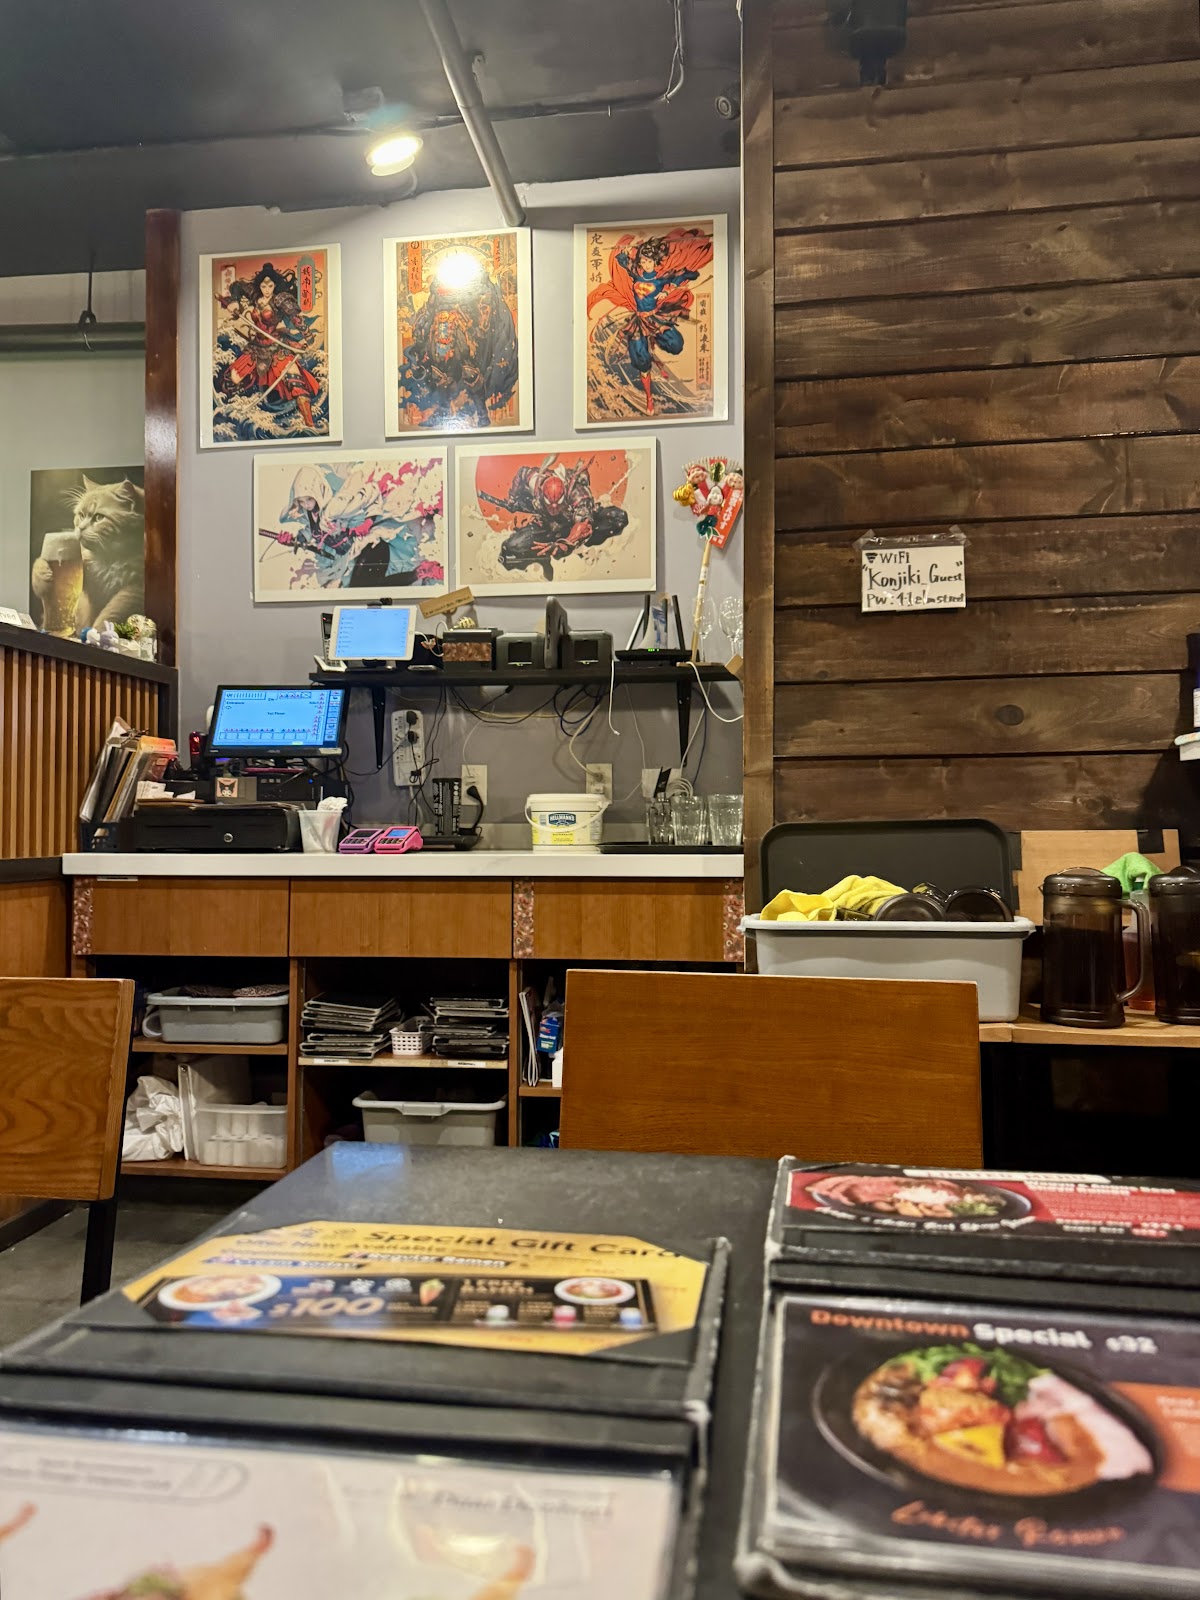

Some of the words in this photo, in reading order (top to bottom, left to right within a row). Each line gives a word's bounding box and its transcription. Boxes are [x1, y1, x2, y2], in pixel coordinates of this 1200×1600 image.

[369, 1231, 496, 1247] Special
[511, 1237, 576, 1252] Gift
[810, 1308, 970, 1339] Downtown
[973, 1322, 1093, 1350] Special
